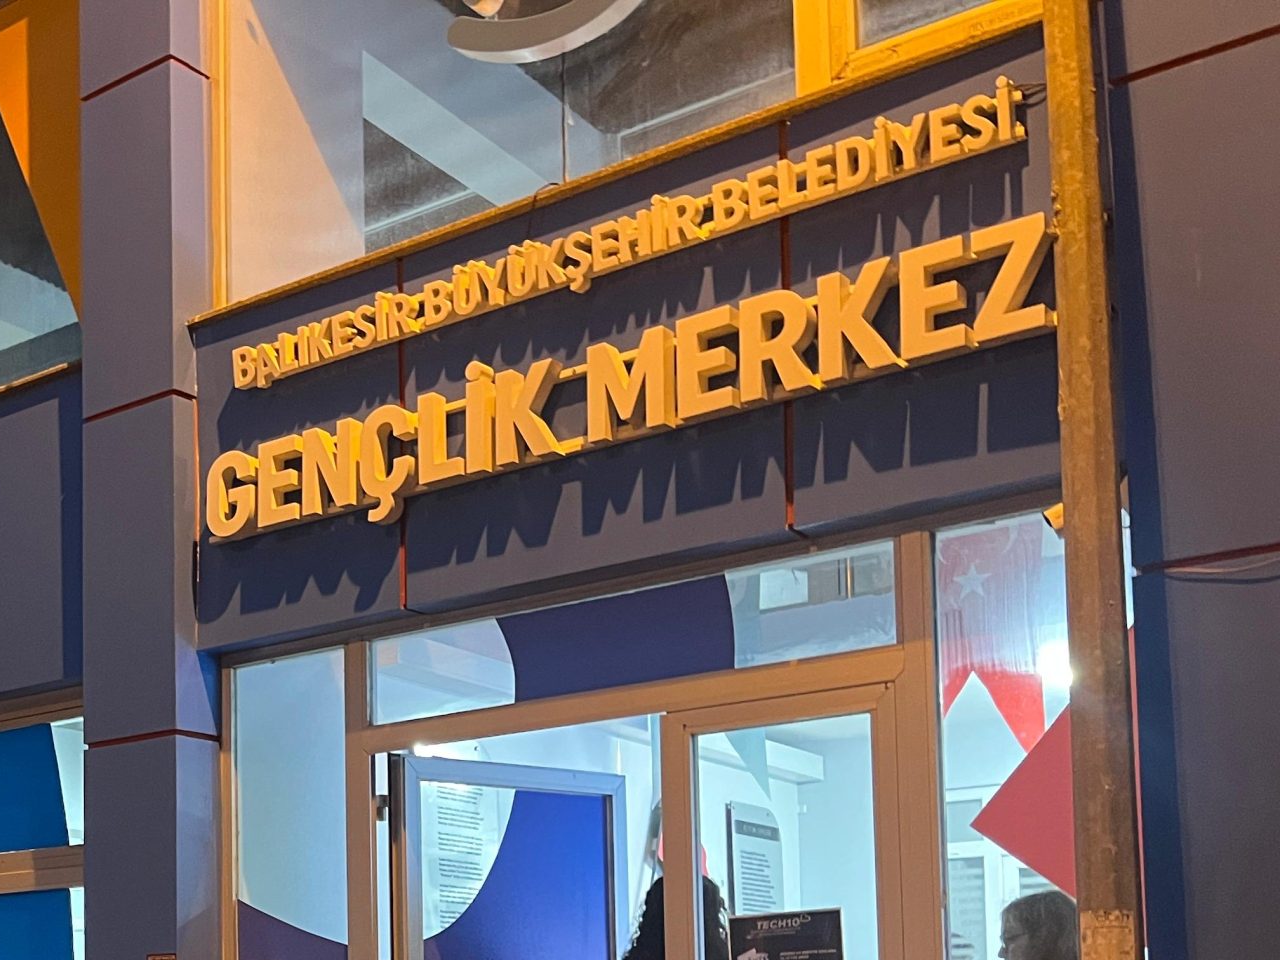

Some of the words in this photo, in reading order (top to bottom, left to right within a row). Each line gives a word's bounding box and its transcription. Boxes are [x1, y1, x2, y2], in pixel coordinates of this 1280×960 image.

[206, 361, 565, 537] GENÇLİK
[587, 212, 1050, 441] MERKEZ
[232, 291, 418, 388] BALIKESİR
[424, 194, 705, 326] BÜYÜKŞEHİR
[712, 75, 1019, 231] BELEDİYESİ
[757, 917, 800, 929] TECH10
